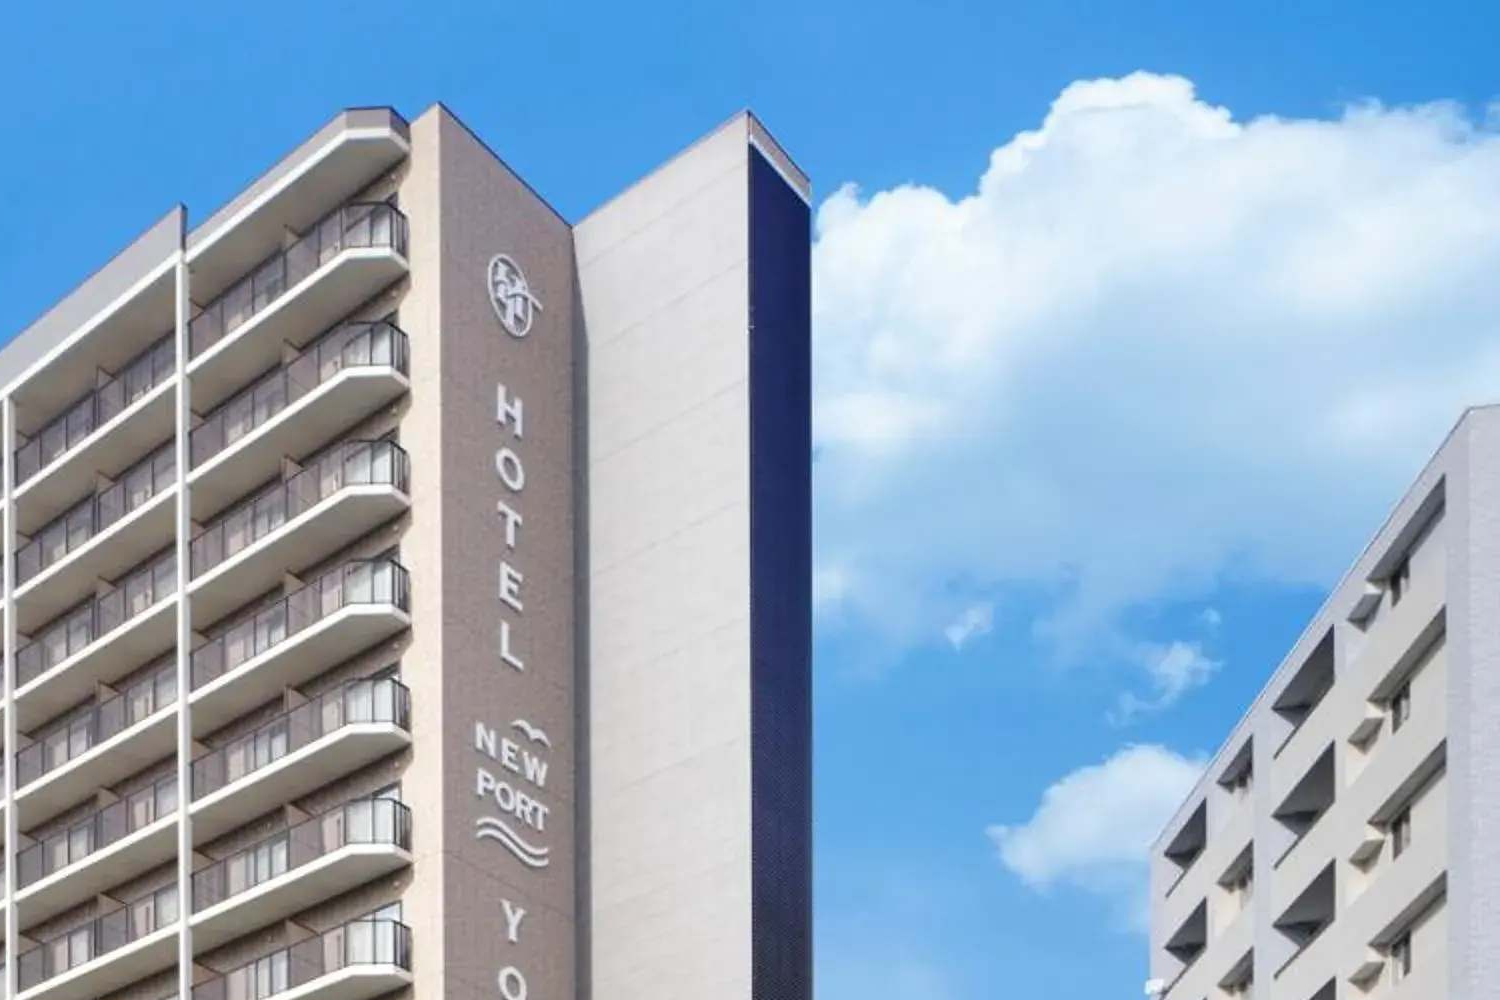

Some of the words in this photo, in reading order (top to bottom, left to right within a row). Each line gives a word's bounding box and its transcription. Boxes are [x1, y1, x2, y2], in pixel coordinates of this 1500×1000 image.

[495, 383, 525, 671] HOTEL
[474, 721, 548, 787] NEW
[476, 767, 549, 832] PORT
